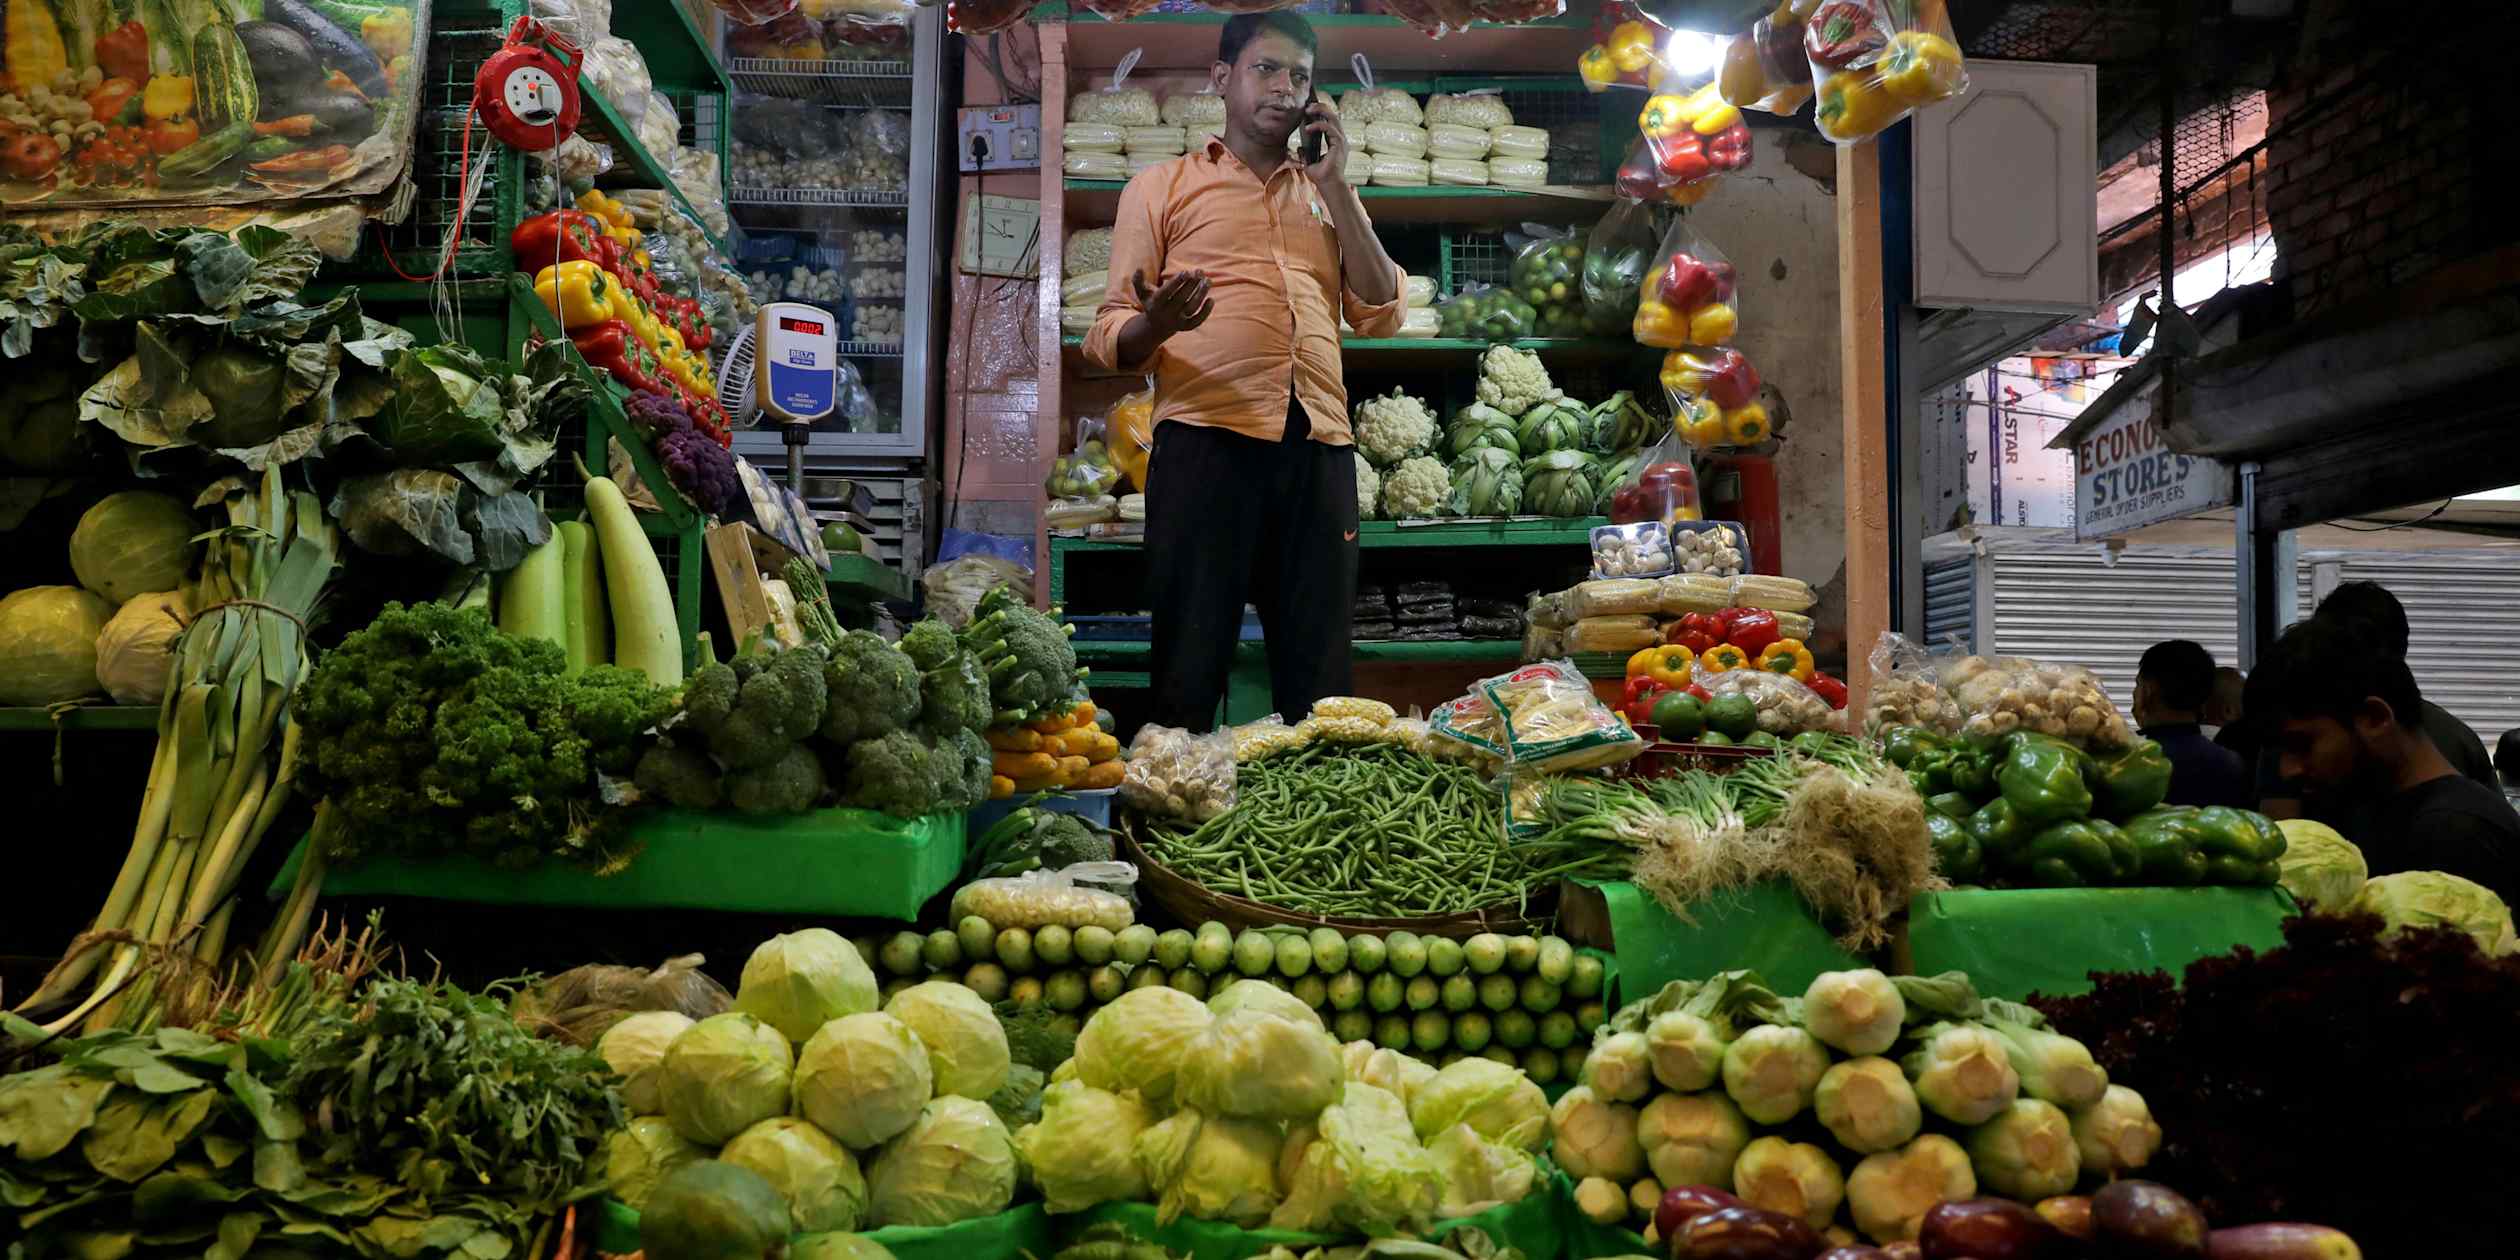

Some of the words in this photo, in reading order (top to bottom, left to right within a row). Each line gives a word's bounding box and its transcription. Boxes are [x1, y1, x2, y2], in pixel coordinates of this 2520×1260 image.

[2004, 385, 2023, 464] ALSTAR
[2080, 416, 2158, 475] ECONO
[2093, 450, 2190, 507] STORES
[2139, 485, 2185, 510] SUPPLIERS
